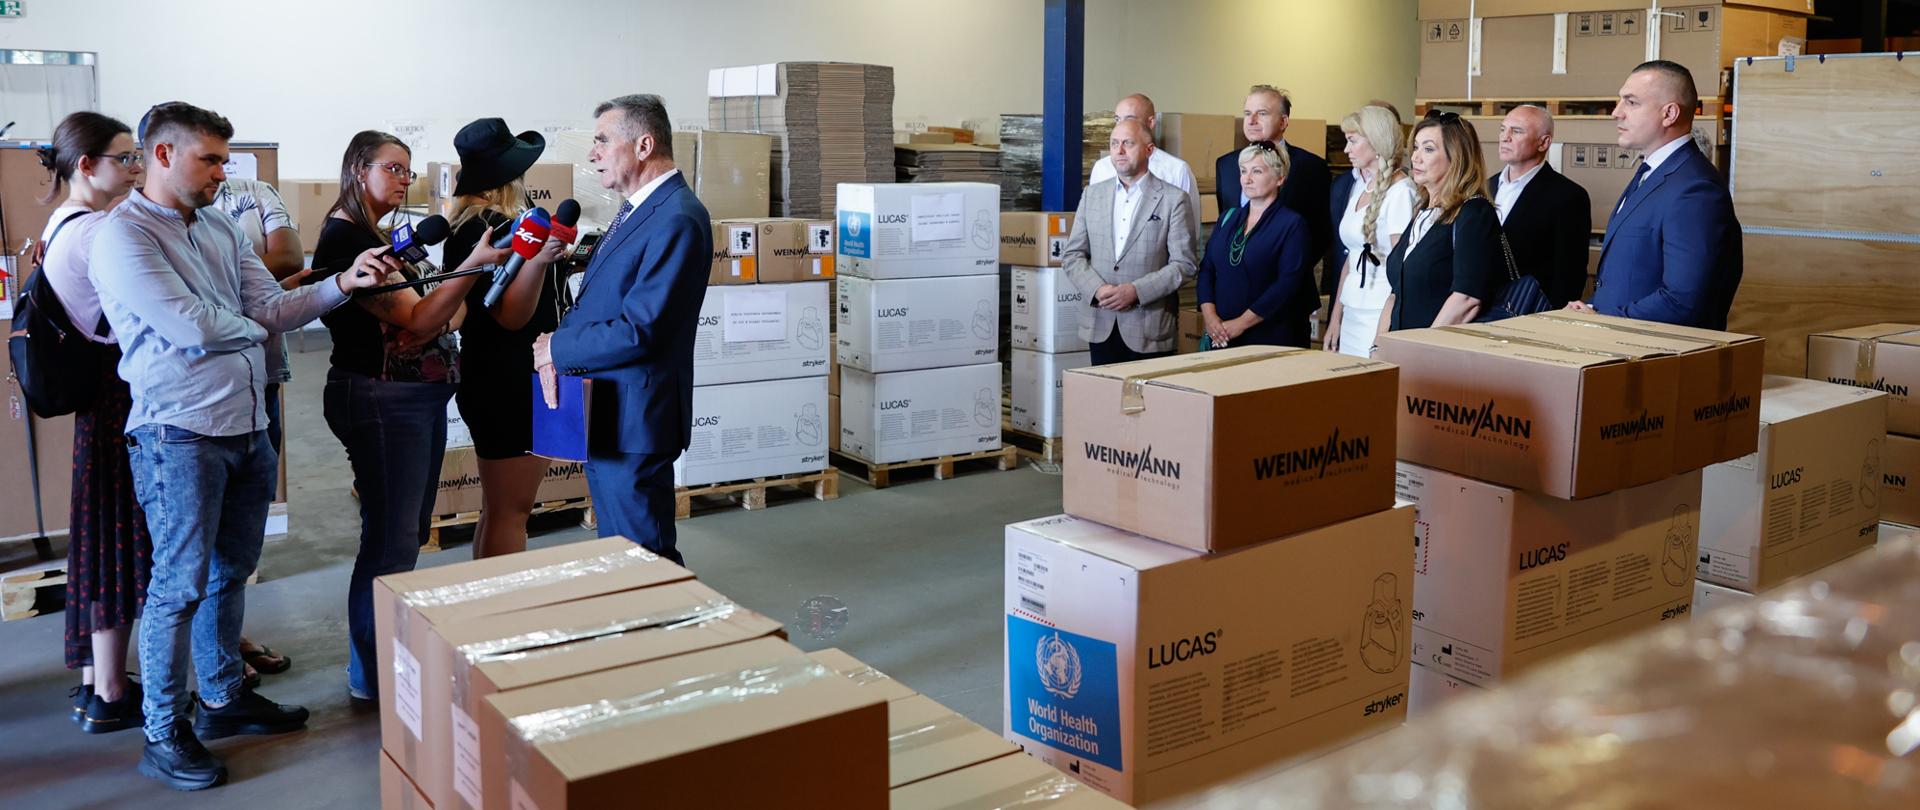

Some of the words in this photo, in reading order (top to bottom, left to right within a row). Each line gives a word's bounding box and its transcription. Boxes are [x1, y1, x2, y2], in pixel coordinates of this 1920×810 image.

[878, 214, 907, 224] LUCAS
[1001, 232, 1036, 248] WEINMANN
[773, 245, 823, 258] WEINMA
[1057, 293, 1082, 302] LUCAS
[878, 308, 907, 318] LUCAS
[698, 317, 718, 327] CAS
[802, 359, 826, 368] stryker
[880, 400, 908, 410] LUCAS
[1694, 392, 1751, 422] WEINMANN
[692, 416, 718, 427] UCAS
[1406, 396, 1531, 439] WEINMANN
[1600, 408, 1664, 441] WEINMANN
[1434, 424, 1470, 437] medical
[801, 455, 825, 464] stryker
[1084, 441, 1180, 480] WEINMANN
[1254, 425, 1370, 481] WEINMANN
[433, 474, 480, 490] EINMANN
[1106, 467, 1134, 479] medical
[1140, 474, 1180, 492] technology
[1660, 603, 1689, 621] stryker
[1363, 692, 1404, 717] stryker
[1027, 696, 1057, 723] World
[1060, 708, 1098, 737] Health
[1028, 715, 1099, 756] Organization
